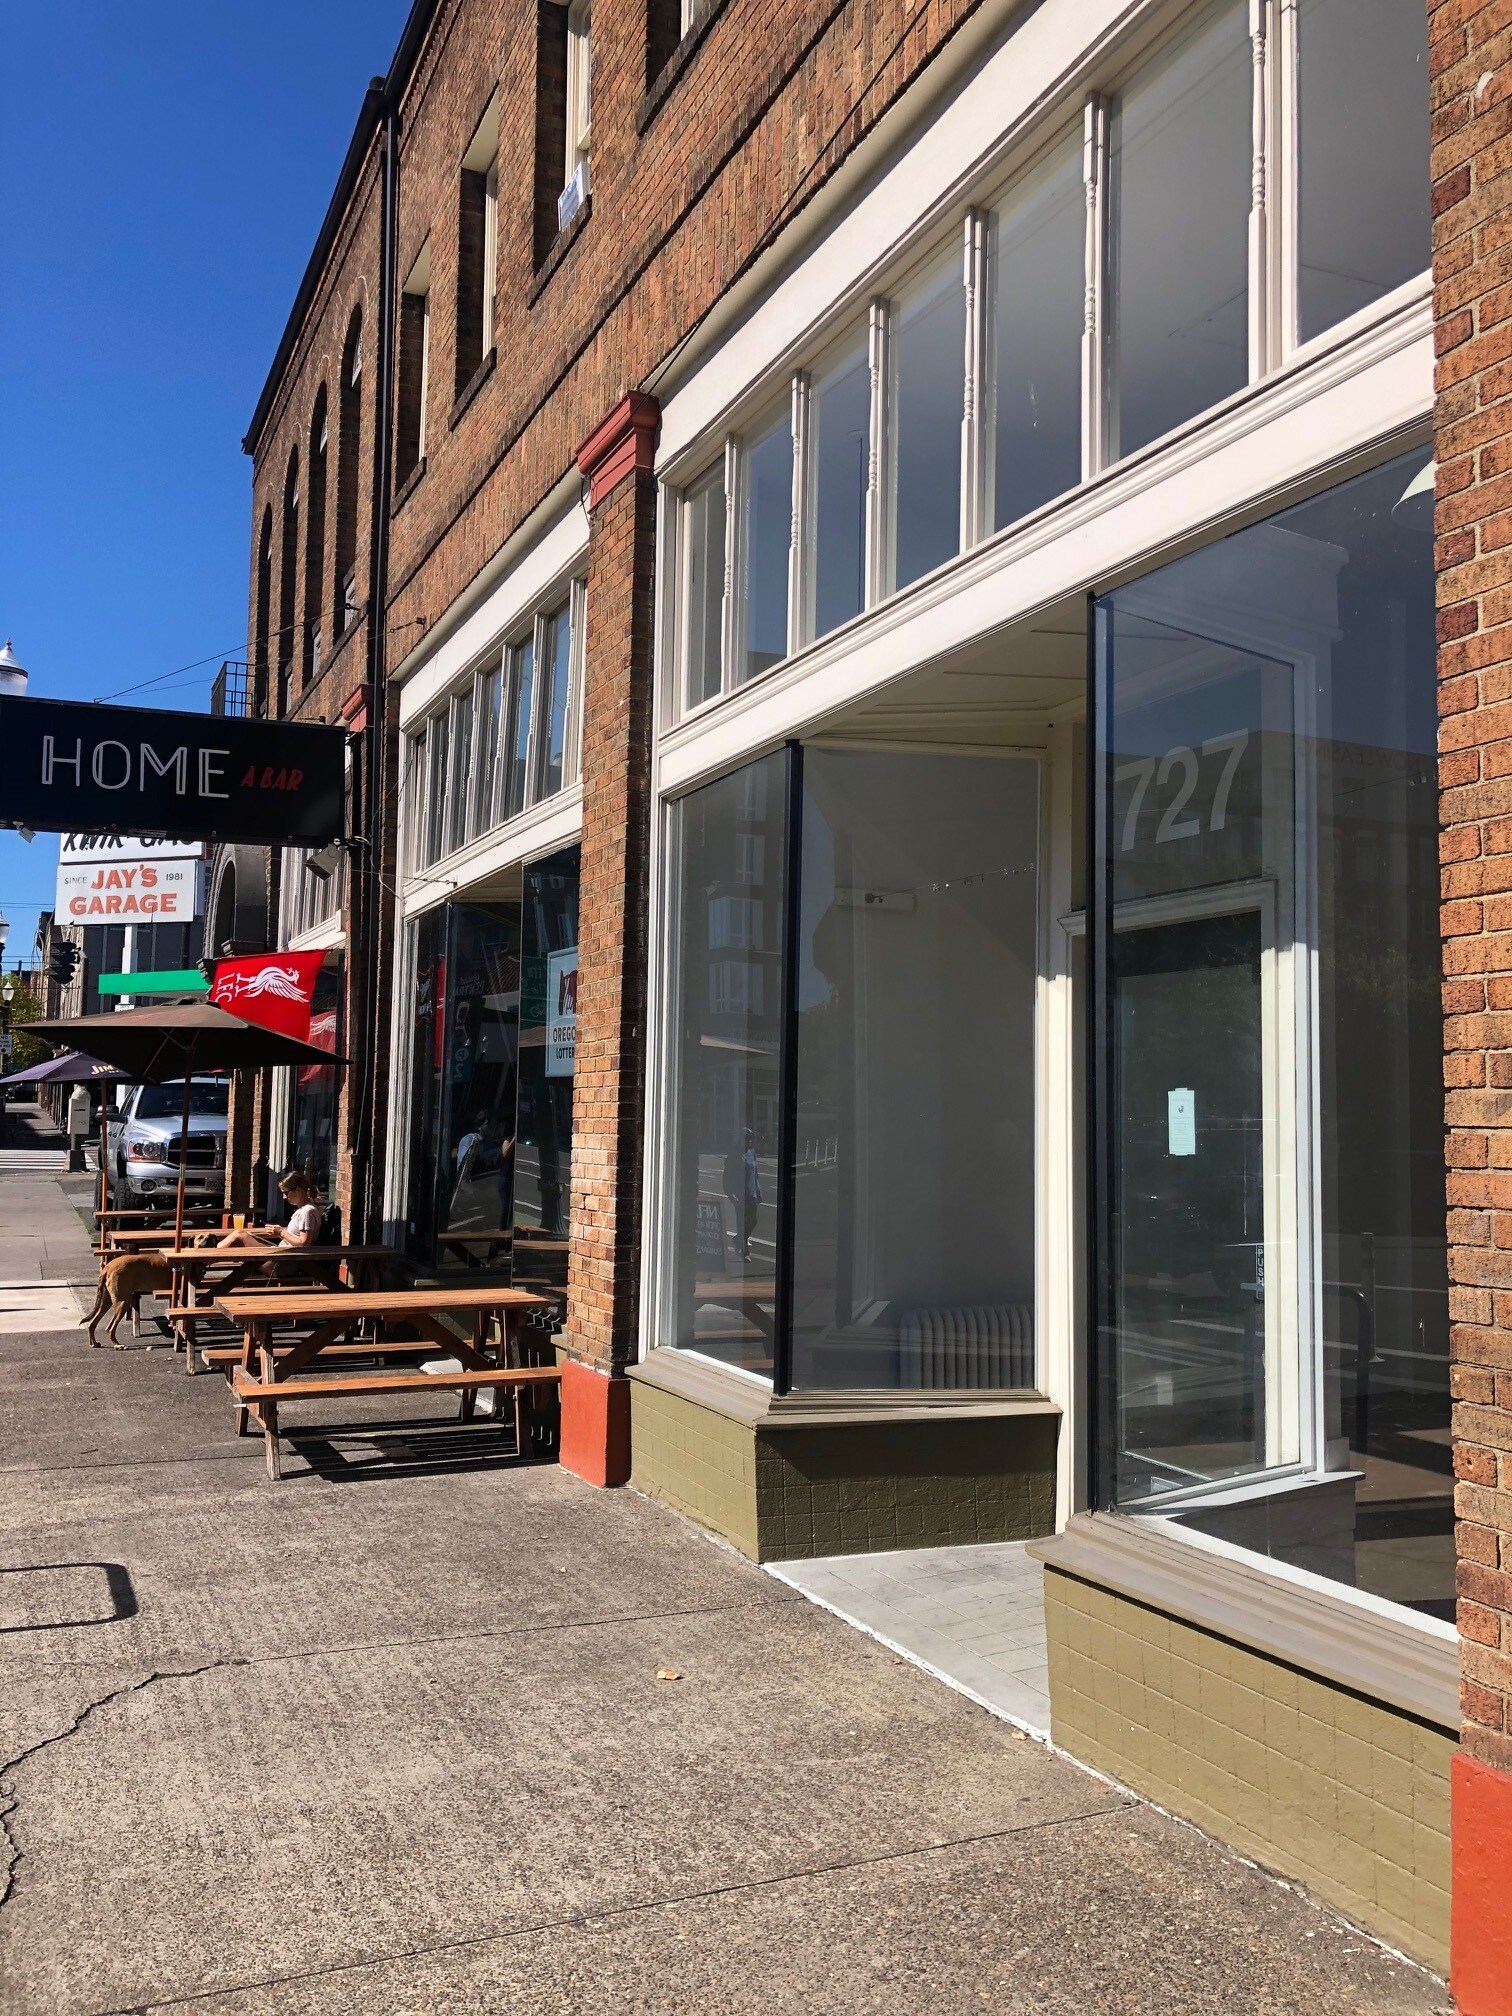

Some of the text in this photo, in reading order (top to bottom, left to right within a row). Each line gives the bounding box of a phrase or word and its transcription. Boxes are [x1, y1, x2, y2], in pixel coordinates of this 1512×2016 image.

[41, 735, 304, 798] HOME A BAR
[1114, 728, 1249, 852] 727
[64, 864, 183, 889] SINCE JAY'S 1981
[69, 893, 177, 915] GARAGE
[553, 1026, 576, 1042] OREGO
[556, 1047, 575, 1060] LOTTER
